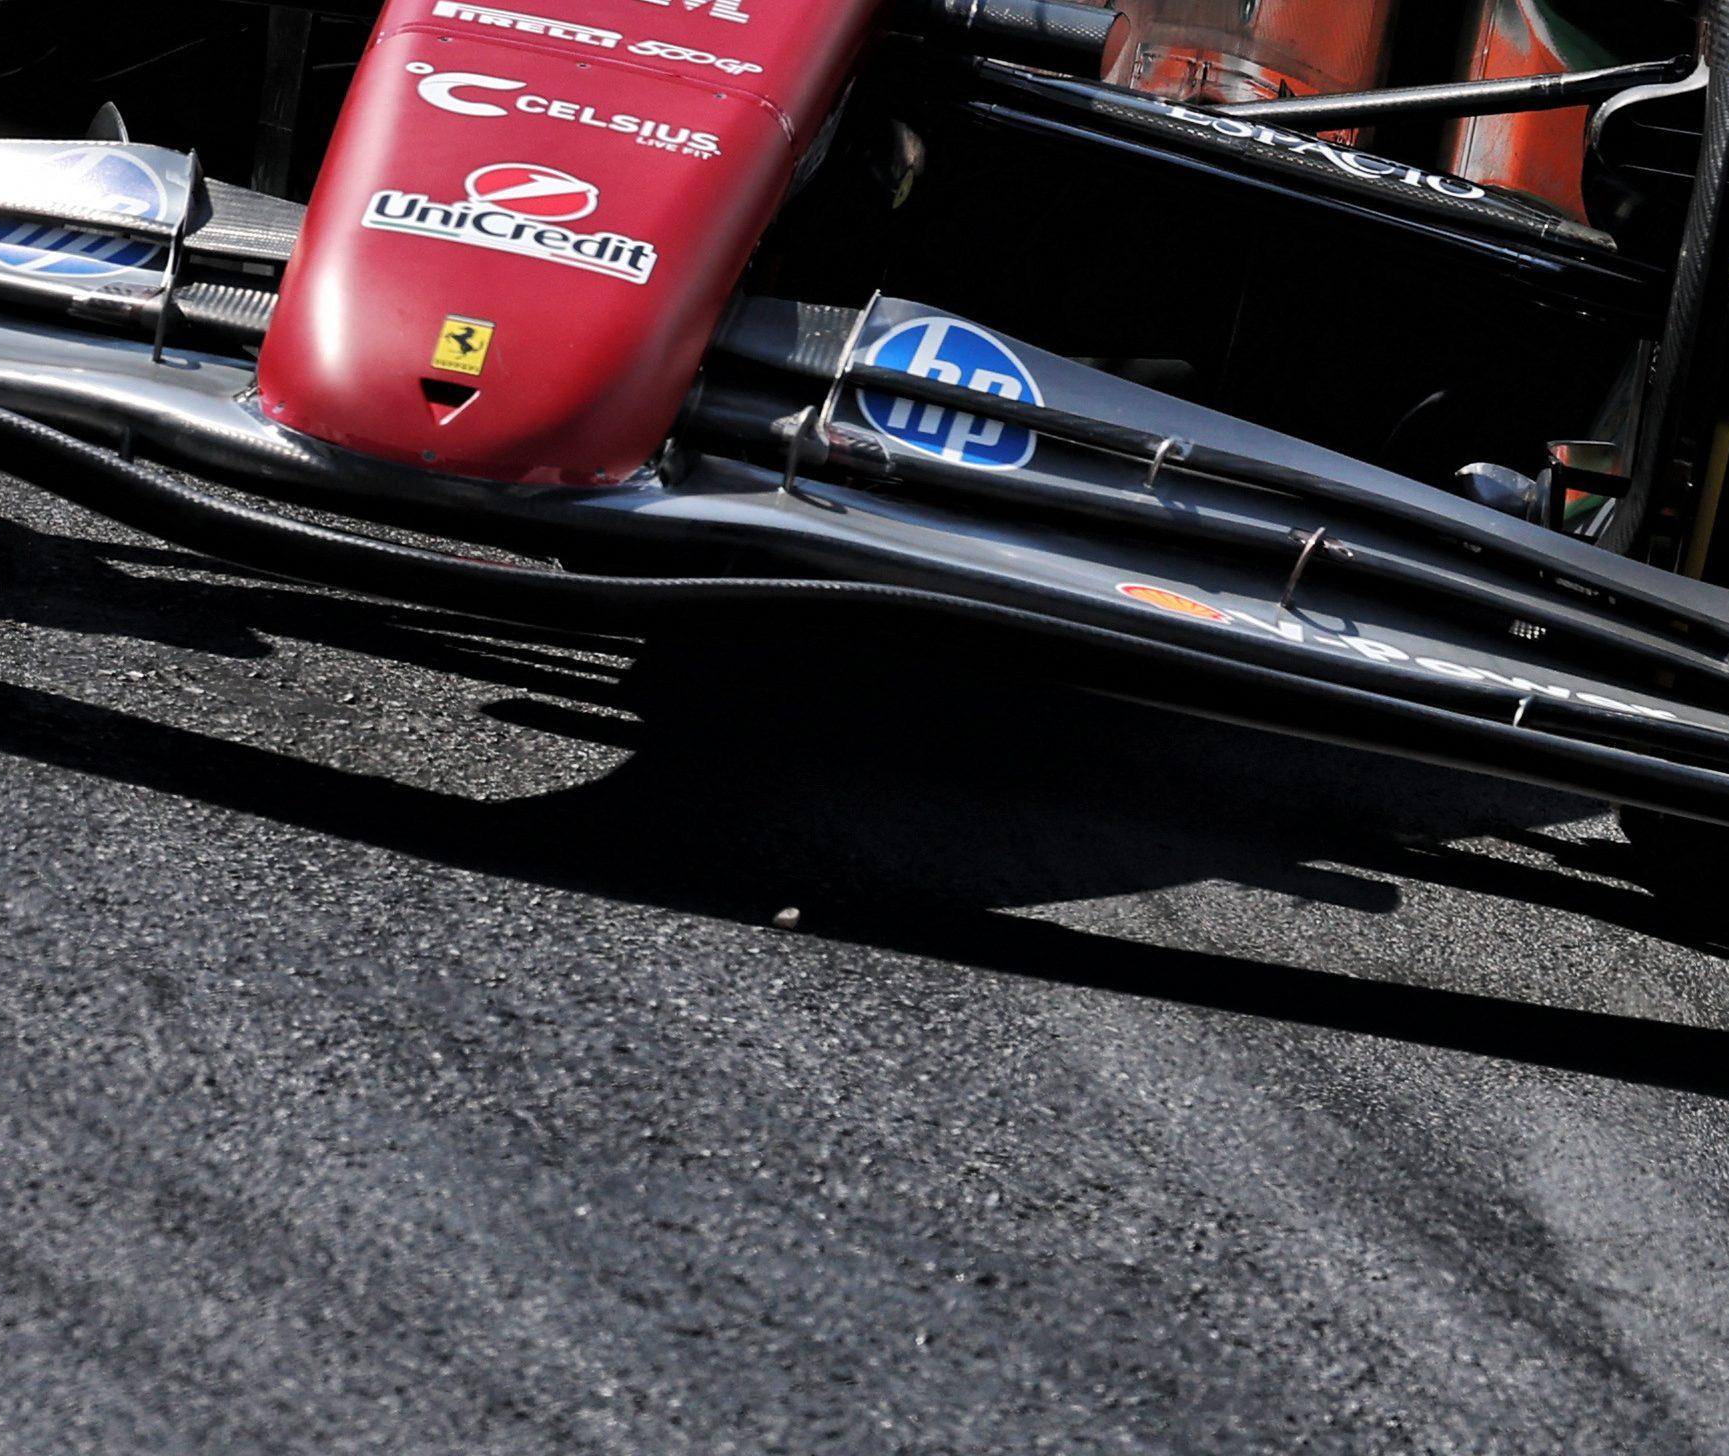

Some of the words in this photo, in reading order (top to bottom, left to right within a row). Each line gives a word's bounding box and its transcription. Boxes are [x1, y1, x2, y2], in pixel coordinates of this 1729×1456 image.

[431, 0, 623, 49] PIRELLI
[516, 95, 721, 153] CELSIUS
[636, 136, 678, 152] LIVE
[682, 146, 713, 160] FIT
[373, 191, 653, 274] UniCredit
[886, 317, 1023, 464] hp
